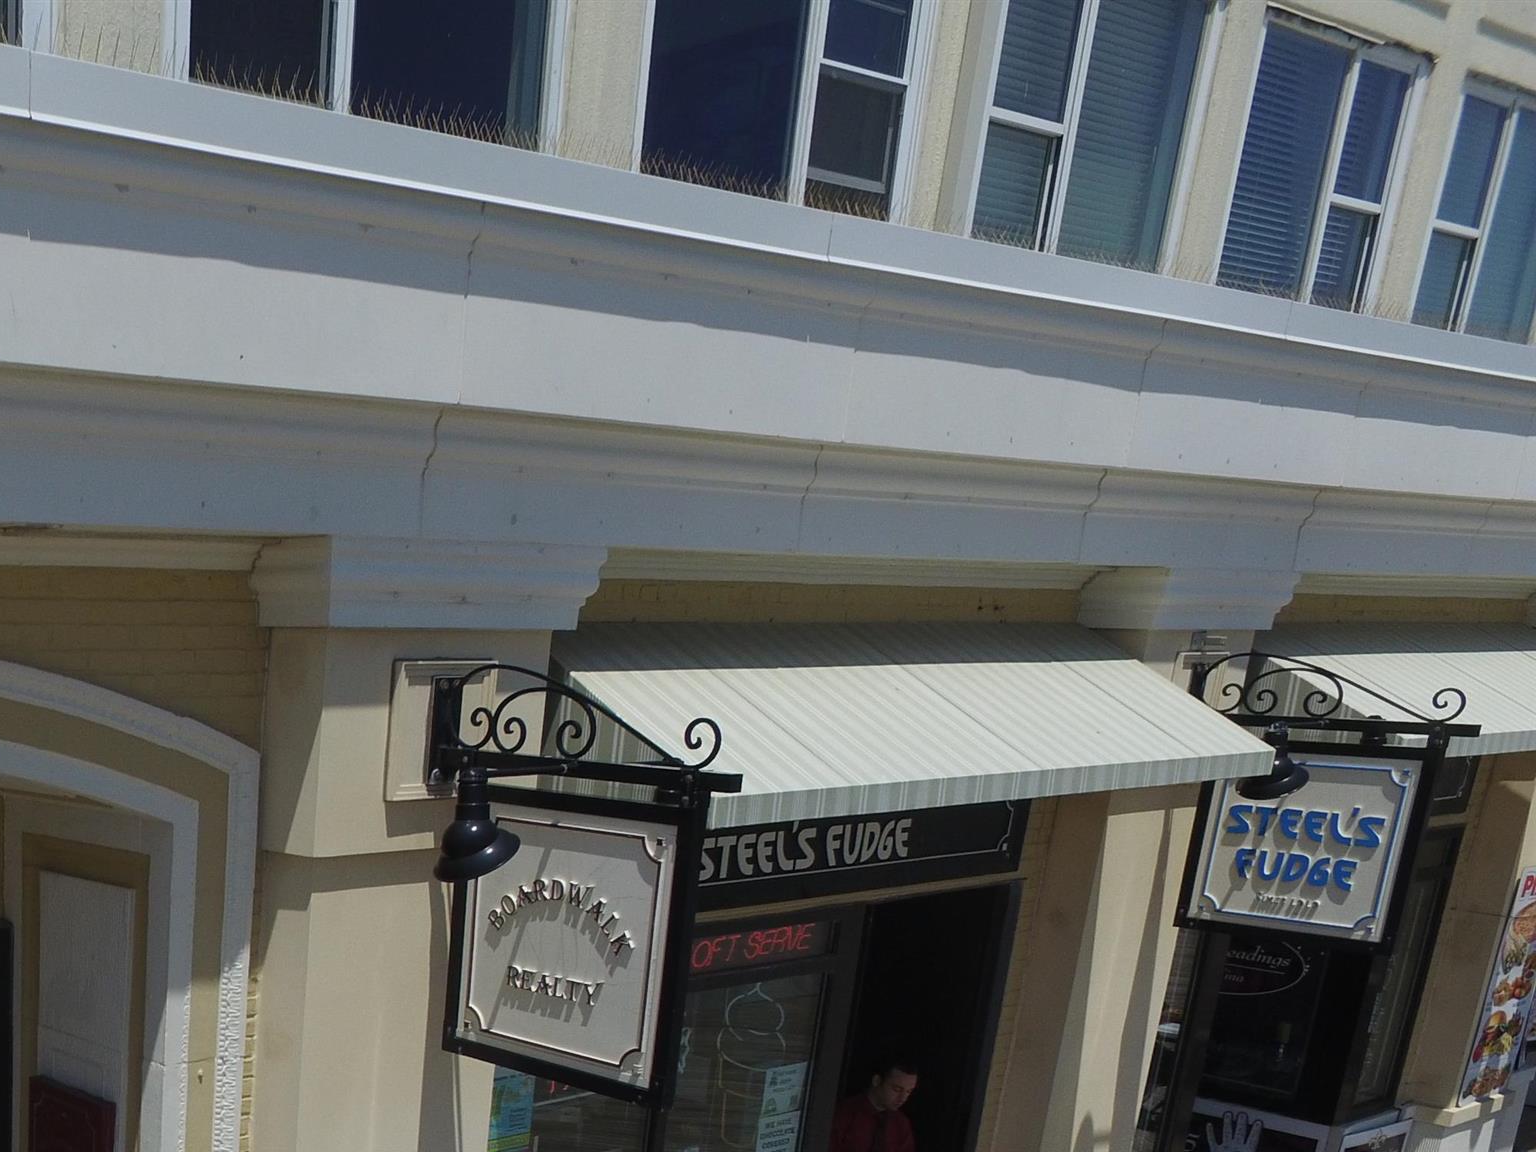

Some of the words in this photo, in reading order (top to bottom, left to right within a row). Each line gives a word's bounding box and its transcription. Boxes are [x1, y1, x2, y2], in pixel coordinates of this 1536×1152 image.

[1227, 804, 1386, 849] STEEL'S
[699, 821, 817, 881] STEEL'S
[826, 818, 912, 867] FUDGE
[1234, 848, 1360, 893] FUDGE
[487, 878, 637, 957] BOARDWALK
[692, 935, 742, 969] OFT
[744, 922, 816, 959] SERVE
[1226, 945, 1292, 967] eadings
[506, 965, 605, 1006] REALTY
